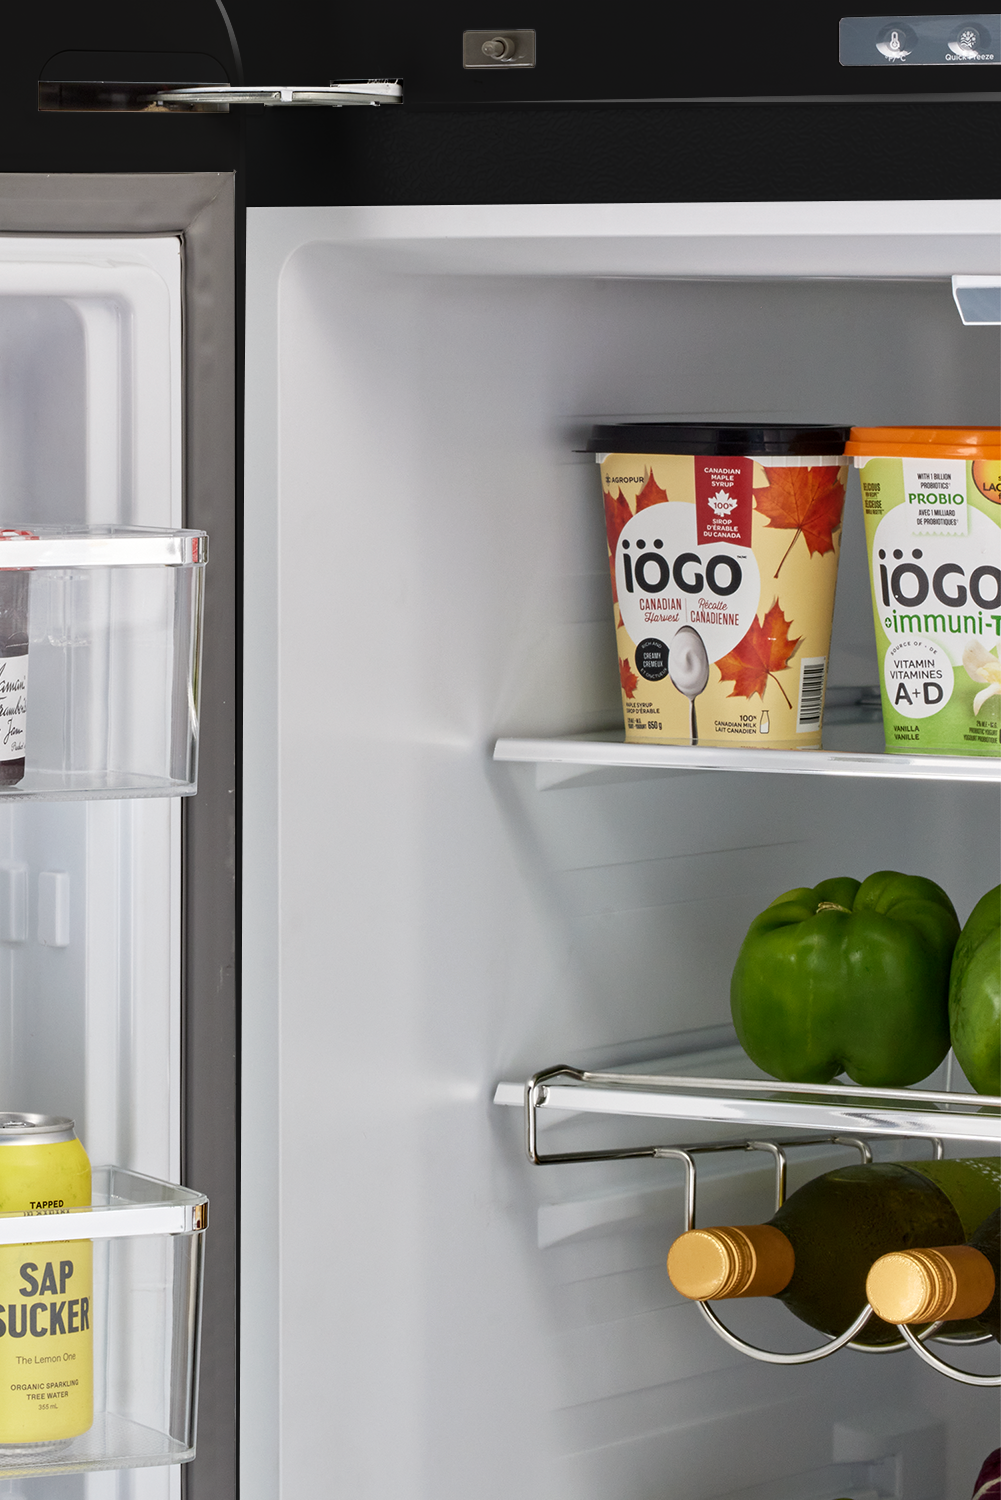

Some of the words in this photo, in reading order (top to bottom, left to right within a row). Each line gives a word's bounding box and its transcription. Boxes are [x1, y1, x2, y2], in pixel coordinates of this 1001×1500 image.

[945, 53, 967, 61] Quick
[612, 476, 644, 484] AGROPUR
[908, 493, 964, 506] PROBIO
[714, 502, 734, 510] 100%
[640, 598, 682, 610] CANADIAN
[644, 612, 680, 623] Harvest
[690, 610, 740, 626] CANADIENNE
[894, 660, 935, 668] VITAMIN
[890, 670, 943, 680] VITAMINES
[714, 720, 742, 728] CANADIAN
[30, 1200, 64, 1210] TAPPED
[19, 1260, 74, 1297] SAP
[16, 1355, 33, 1365] The
[34, 1354, 62, 1364] Lemon
[62, 1352, 76, 1362] One
[10, 1382, 45, 1391] ORGANIC
[46, 1378, 79, 1390] SPARKLING
[46, 1390, 69, 1400] WATER
